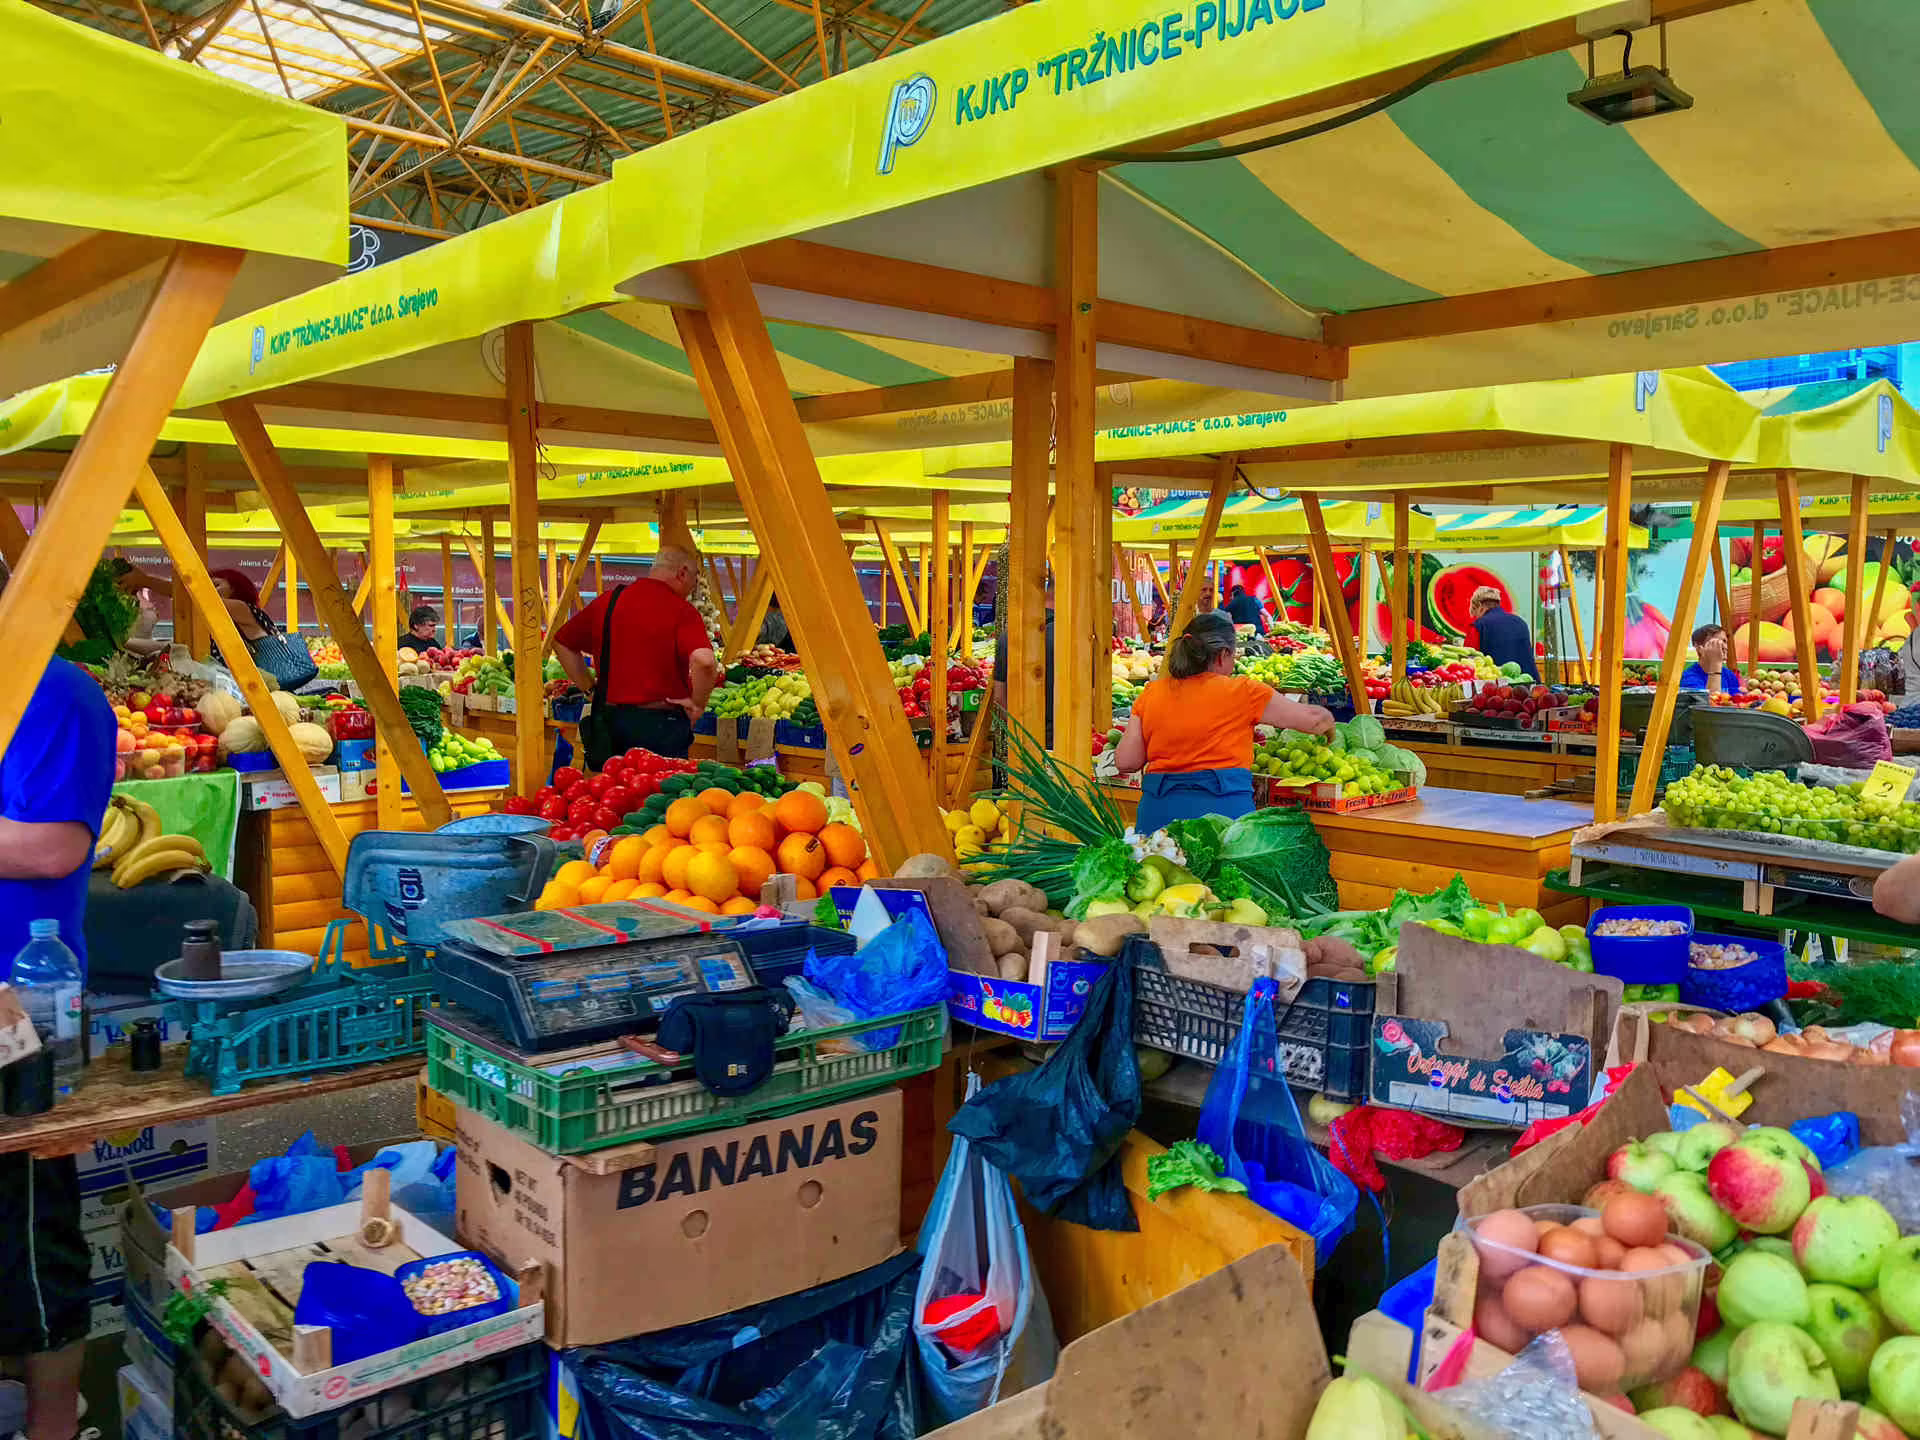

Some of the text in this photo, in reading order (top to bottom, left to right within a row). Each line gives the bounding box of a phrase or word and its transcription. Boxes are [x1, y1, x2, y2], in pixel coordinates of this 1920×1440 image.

[955, 67, 1029, 126] KJKP
[398, 287, 439, 318] Sarajevo
[1237, 410, 1287, 428] Sarajevo
[1874, 781, 1894, 798] 2
[1470, 1071, 1486, 1092] di
[615, 1110, 880, 1211] BANANAS
